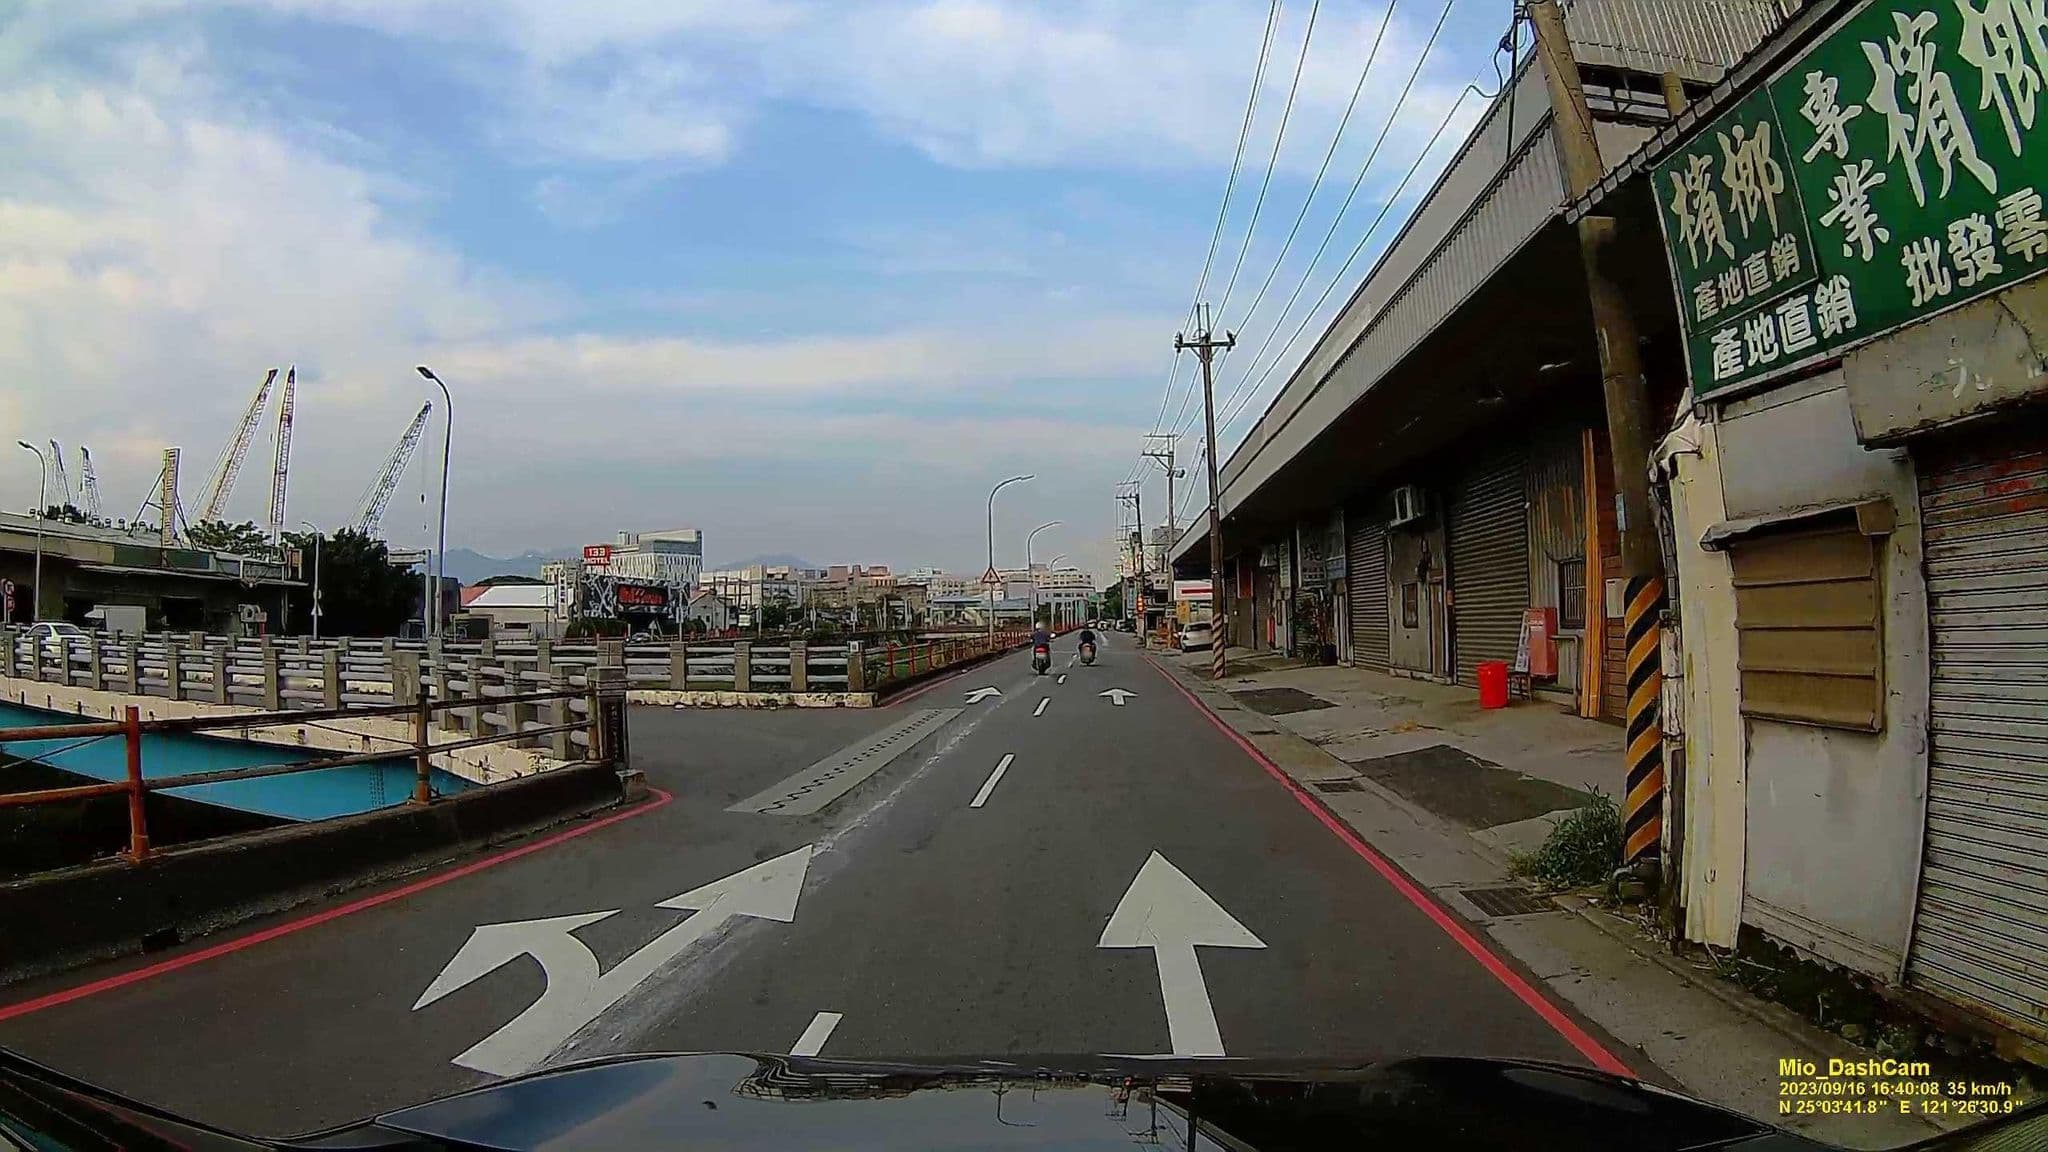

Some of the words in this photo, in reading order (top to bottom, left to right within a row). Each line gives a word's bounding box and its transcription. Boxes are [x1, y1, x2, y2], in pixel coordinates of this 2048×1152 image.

[1669, 121, 1785, 270] 檳榔
[1798, 70, 1890, 262] 專業
[1692, 232, 1801, 323] 產地直銷
[1901, 187, 2048, 308] 批發零
[1711, 274, 1858, 381] 產地直銷
[588, 547, 606, 557] 133
